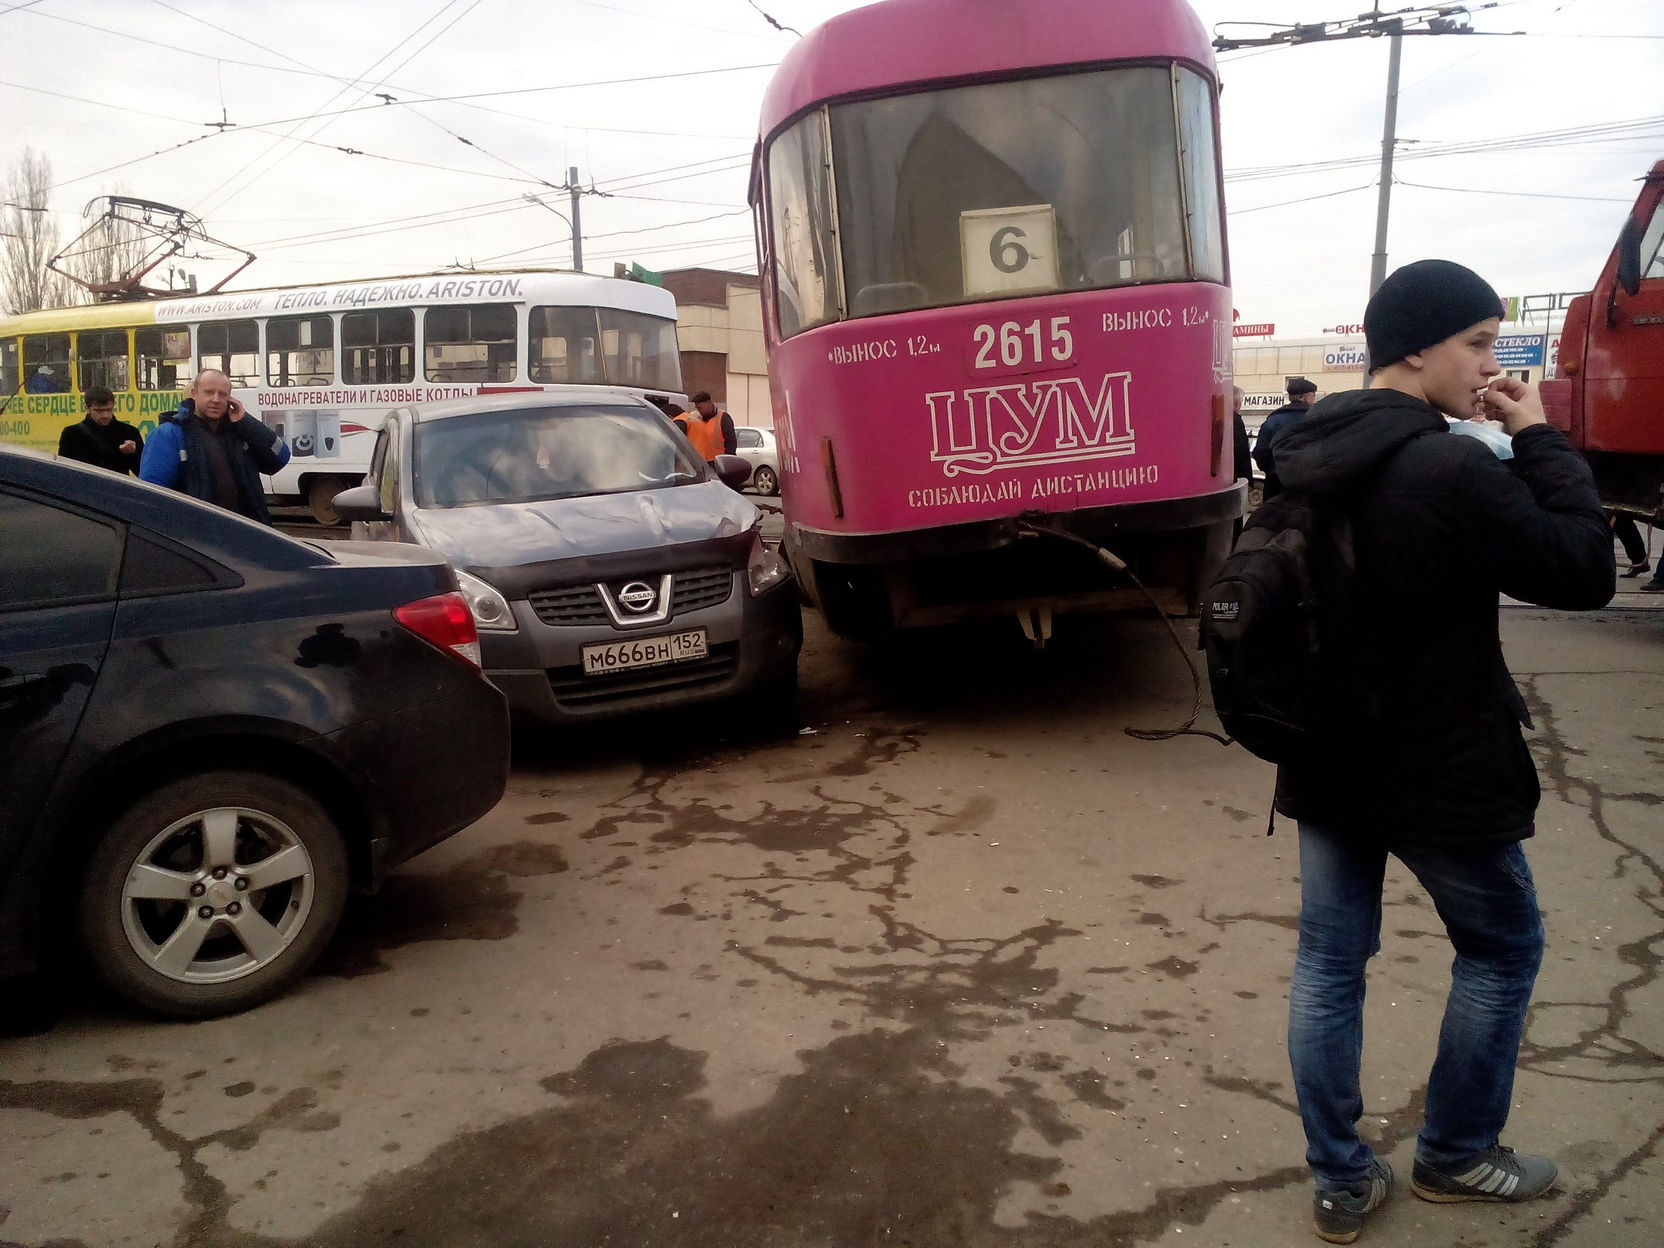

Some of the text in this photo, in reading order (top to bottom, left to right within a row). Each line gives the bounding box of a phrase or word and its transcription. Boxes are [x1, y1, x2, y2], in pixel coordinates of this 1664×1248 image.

[989, 226, 1029, 274] 6
[273, 278, 524, 310] ТЕПЛО. НАДЕЖНО. ARISTON.
[158, 298, 262, 317] WWW.ARISTON.COM
[1102, 307, 1172, 332] ВЫНОС
[1233, 325, 1269, 336] АМИНЫ
[1335, 324, 1367, 335] ОКН
[833, 339, 897, 365] ВЫНОС
[973, 316, 1074, 369] 2615
[1493, 336, 1541, 347] СТЕКЛО
[1325, 352, 1366, 364] ОКНА
[27, 395, 76, 417] СЕРДЦЕ
[80, 394, 135, 414] ВЕГО
[258, 389, 358, 408] ВОДОНАГРЕВАТЕЛИ
[360, 389, 367, 403] И
[370, 388, 423, 403] ГАЗОВЫЕ
[1243, 396, 1285, 406] МАГАЗИН
[925, 371, 1136, 478] ЦУМ
[908, 464, 1159, 509] СОБЛЮДАЙ ДИСТАНЦИЮ
[623, 592, 654, 601] NISSAN
[589, 642, 670, 668] М666ВН
[673, 633, 701, 650] 152
